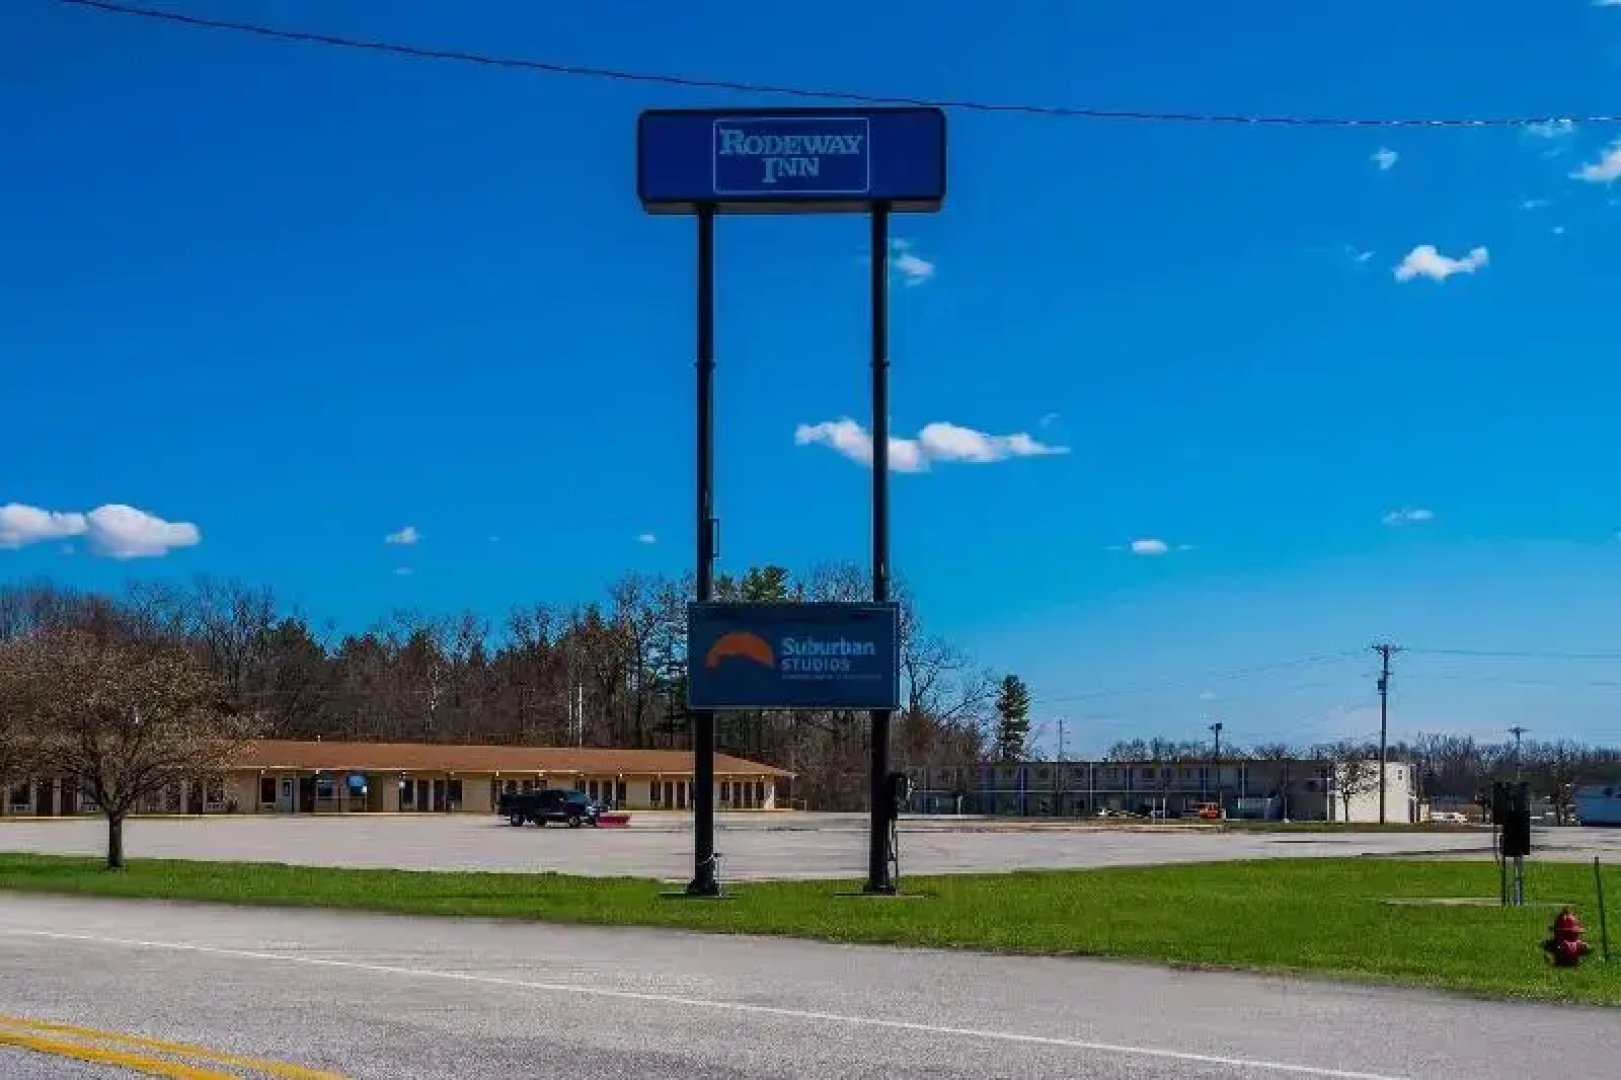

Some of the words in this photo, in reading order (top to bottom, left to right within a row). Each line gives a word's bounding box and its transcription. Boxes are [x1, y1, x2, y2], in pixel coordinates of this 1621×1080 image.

[719, 129, 862, 155] RODEWAY
[762, 157, 819, 183] INN
[781, 637, 876, 655] Suburban
[781, 657, 850, 672] STUDIOS
